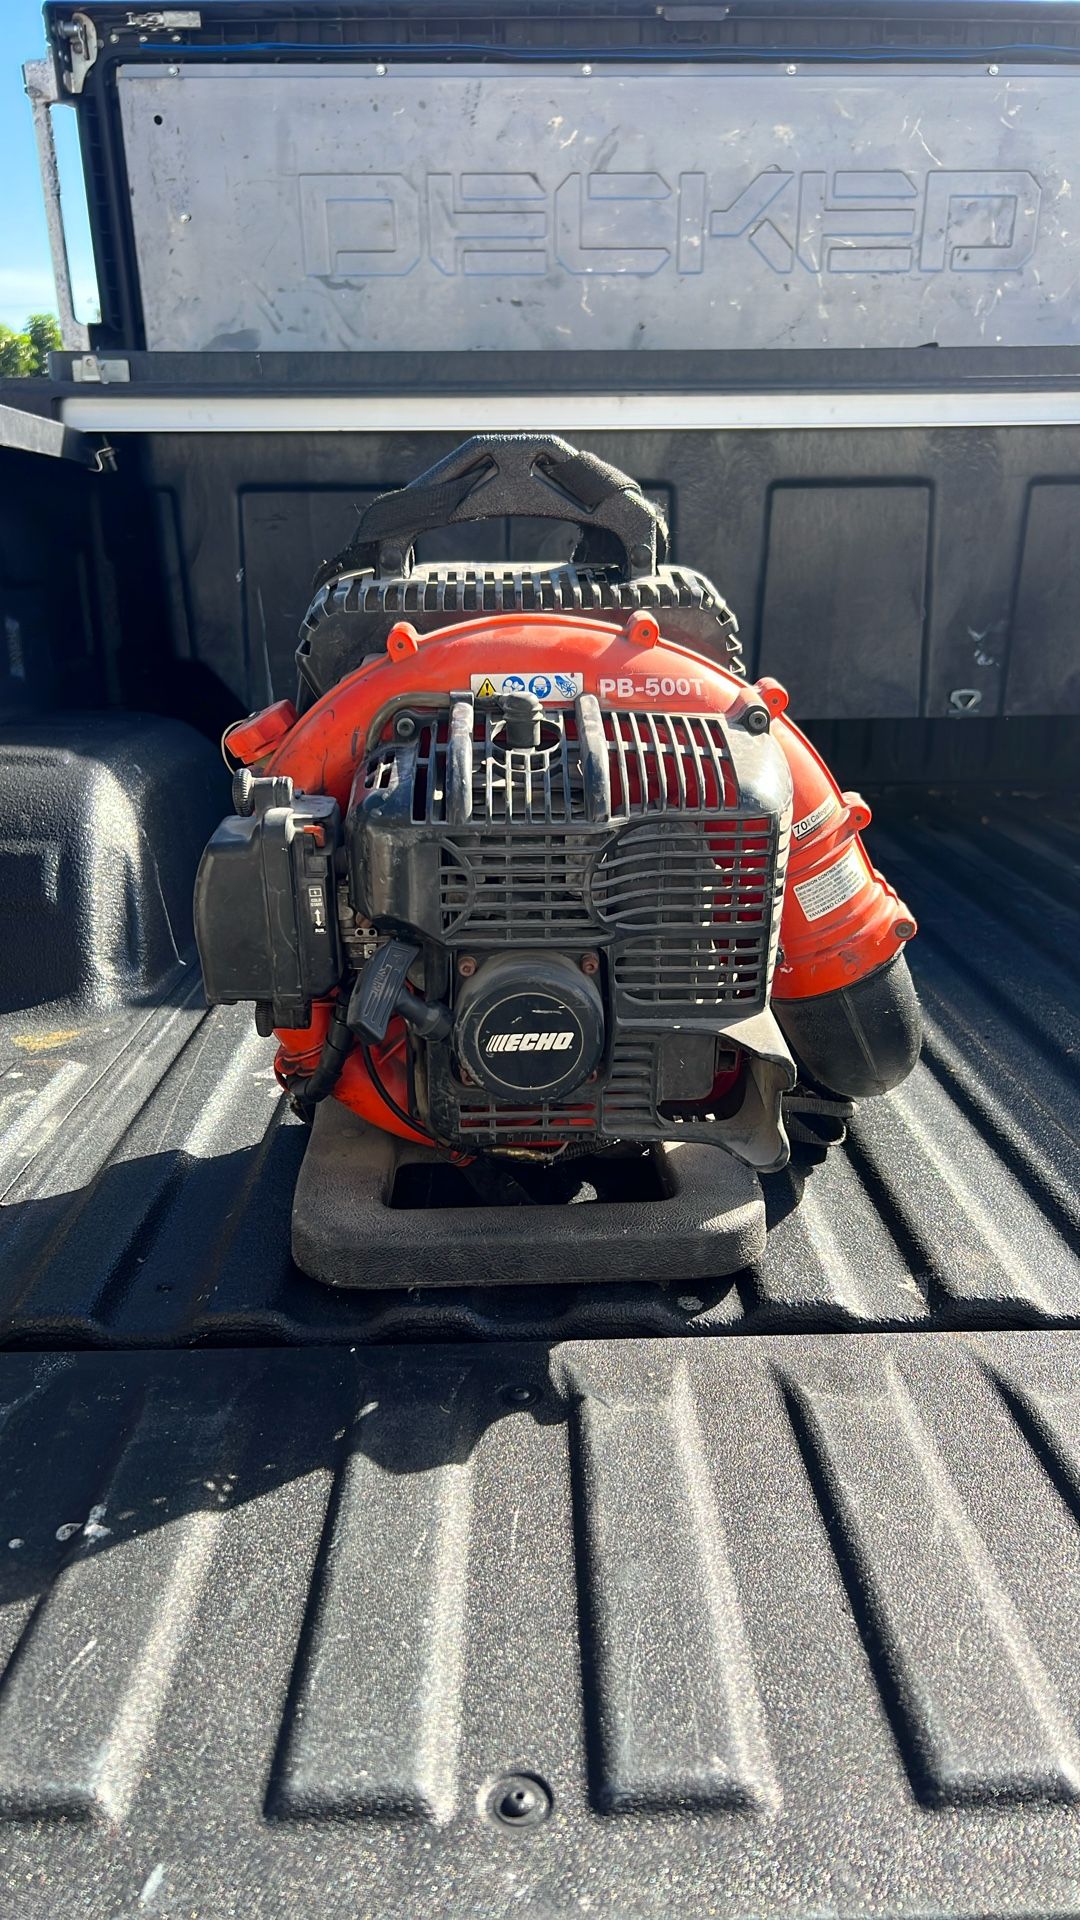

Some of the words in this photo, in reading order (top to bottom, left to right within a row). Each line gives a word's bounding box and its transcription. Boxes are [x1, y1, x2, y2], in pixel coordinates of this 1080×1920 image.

[299, 168, 1043, 276] DECKED
[600, 678, 704, 698] PB-500T
[793, 821, 808, 834] 70
[504, 1032, 574, 1052] ECHO
